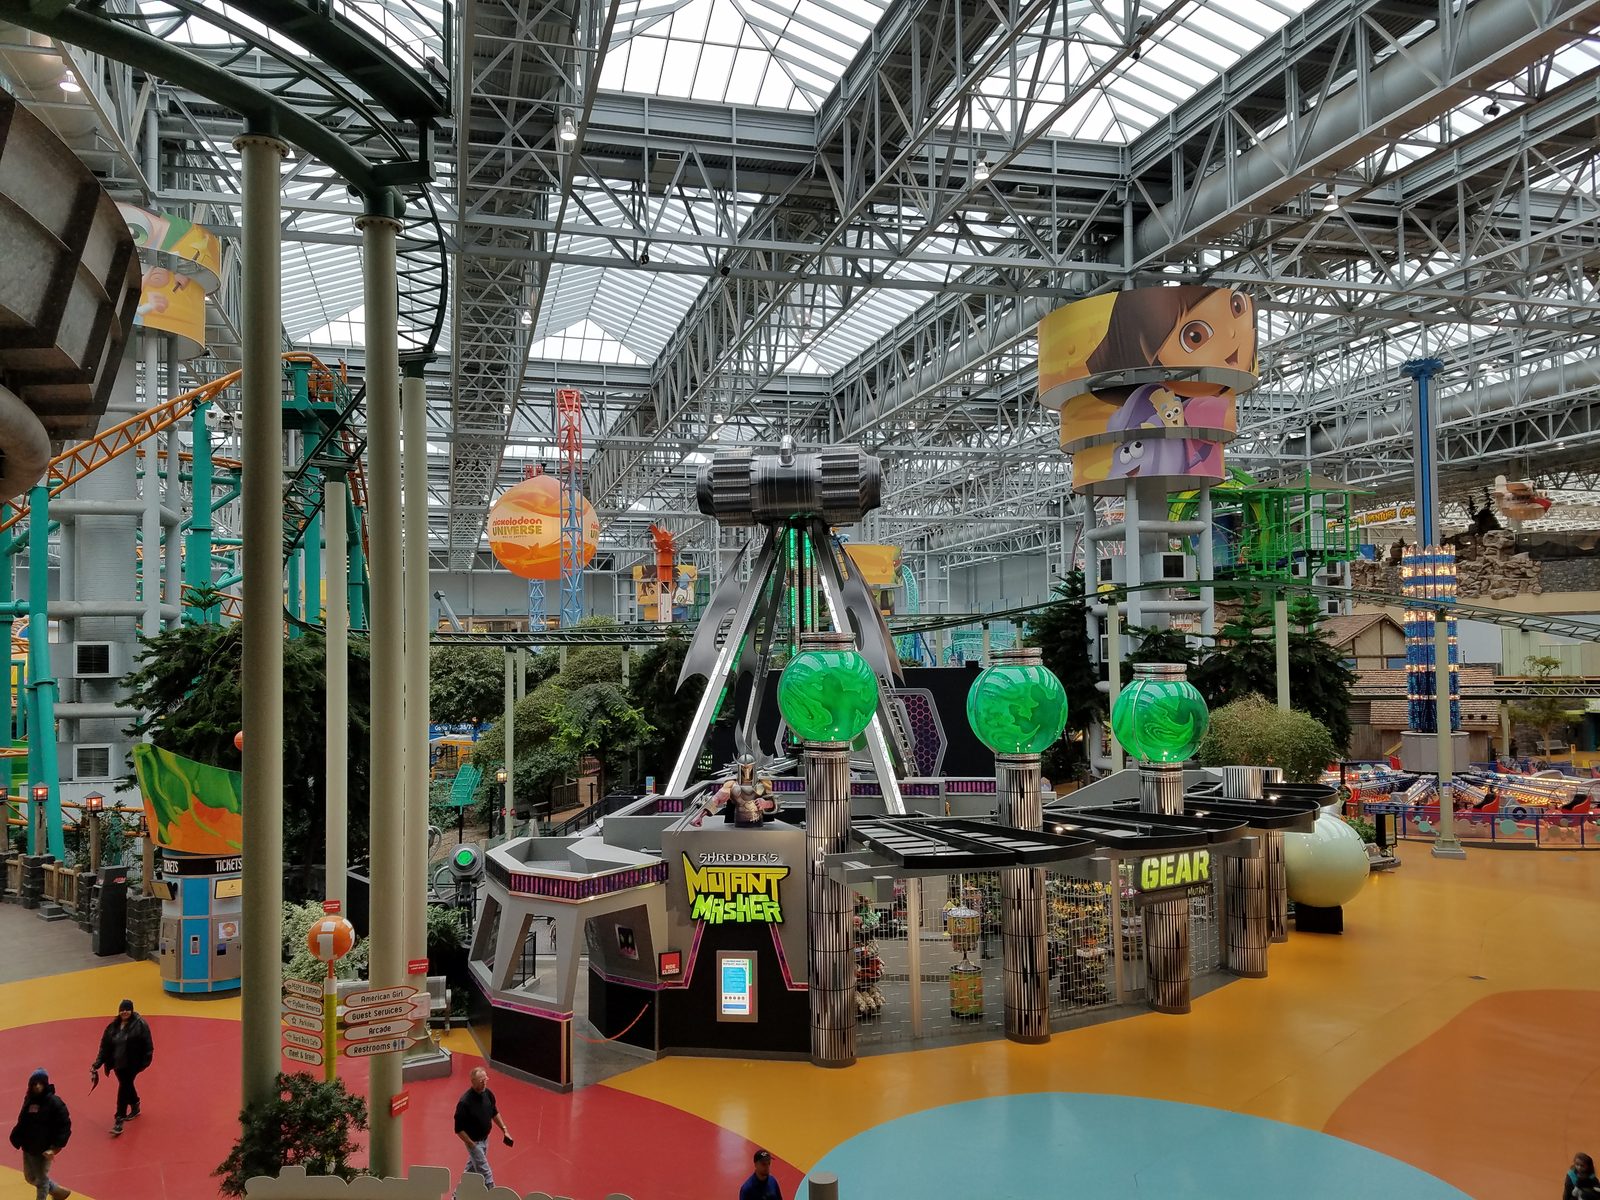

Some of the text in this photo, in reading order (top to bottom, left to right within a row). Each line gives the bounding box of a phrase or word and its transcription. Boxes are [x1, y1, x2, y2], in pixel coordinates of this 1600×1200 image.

[1400, 504, 1416, 519] GOL
[492, 516, 542, 527] nickelodeon
[492, 525, 542, 536] UNIVERSE
[699, 851, 779, 864] SHREDDER'S
[215, 858, 243, 872] TICKETS
[1141, 850, 1209, 890] GEAR
[682, 851, 789, 905] MUTANT
[691, 893, 783, 924] MASHER
[360, 990, 404, 1003] American Girl
[352, 1006, 403, 1020] Guest Services
[368, 1024, 392, 1035] Arcade
[353, 1043, 391, 1054] Restrooms
